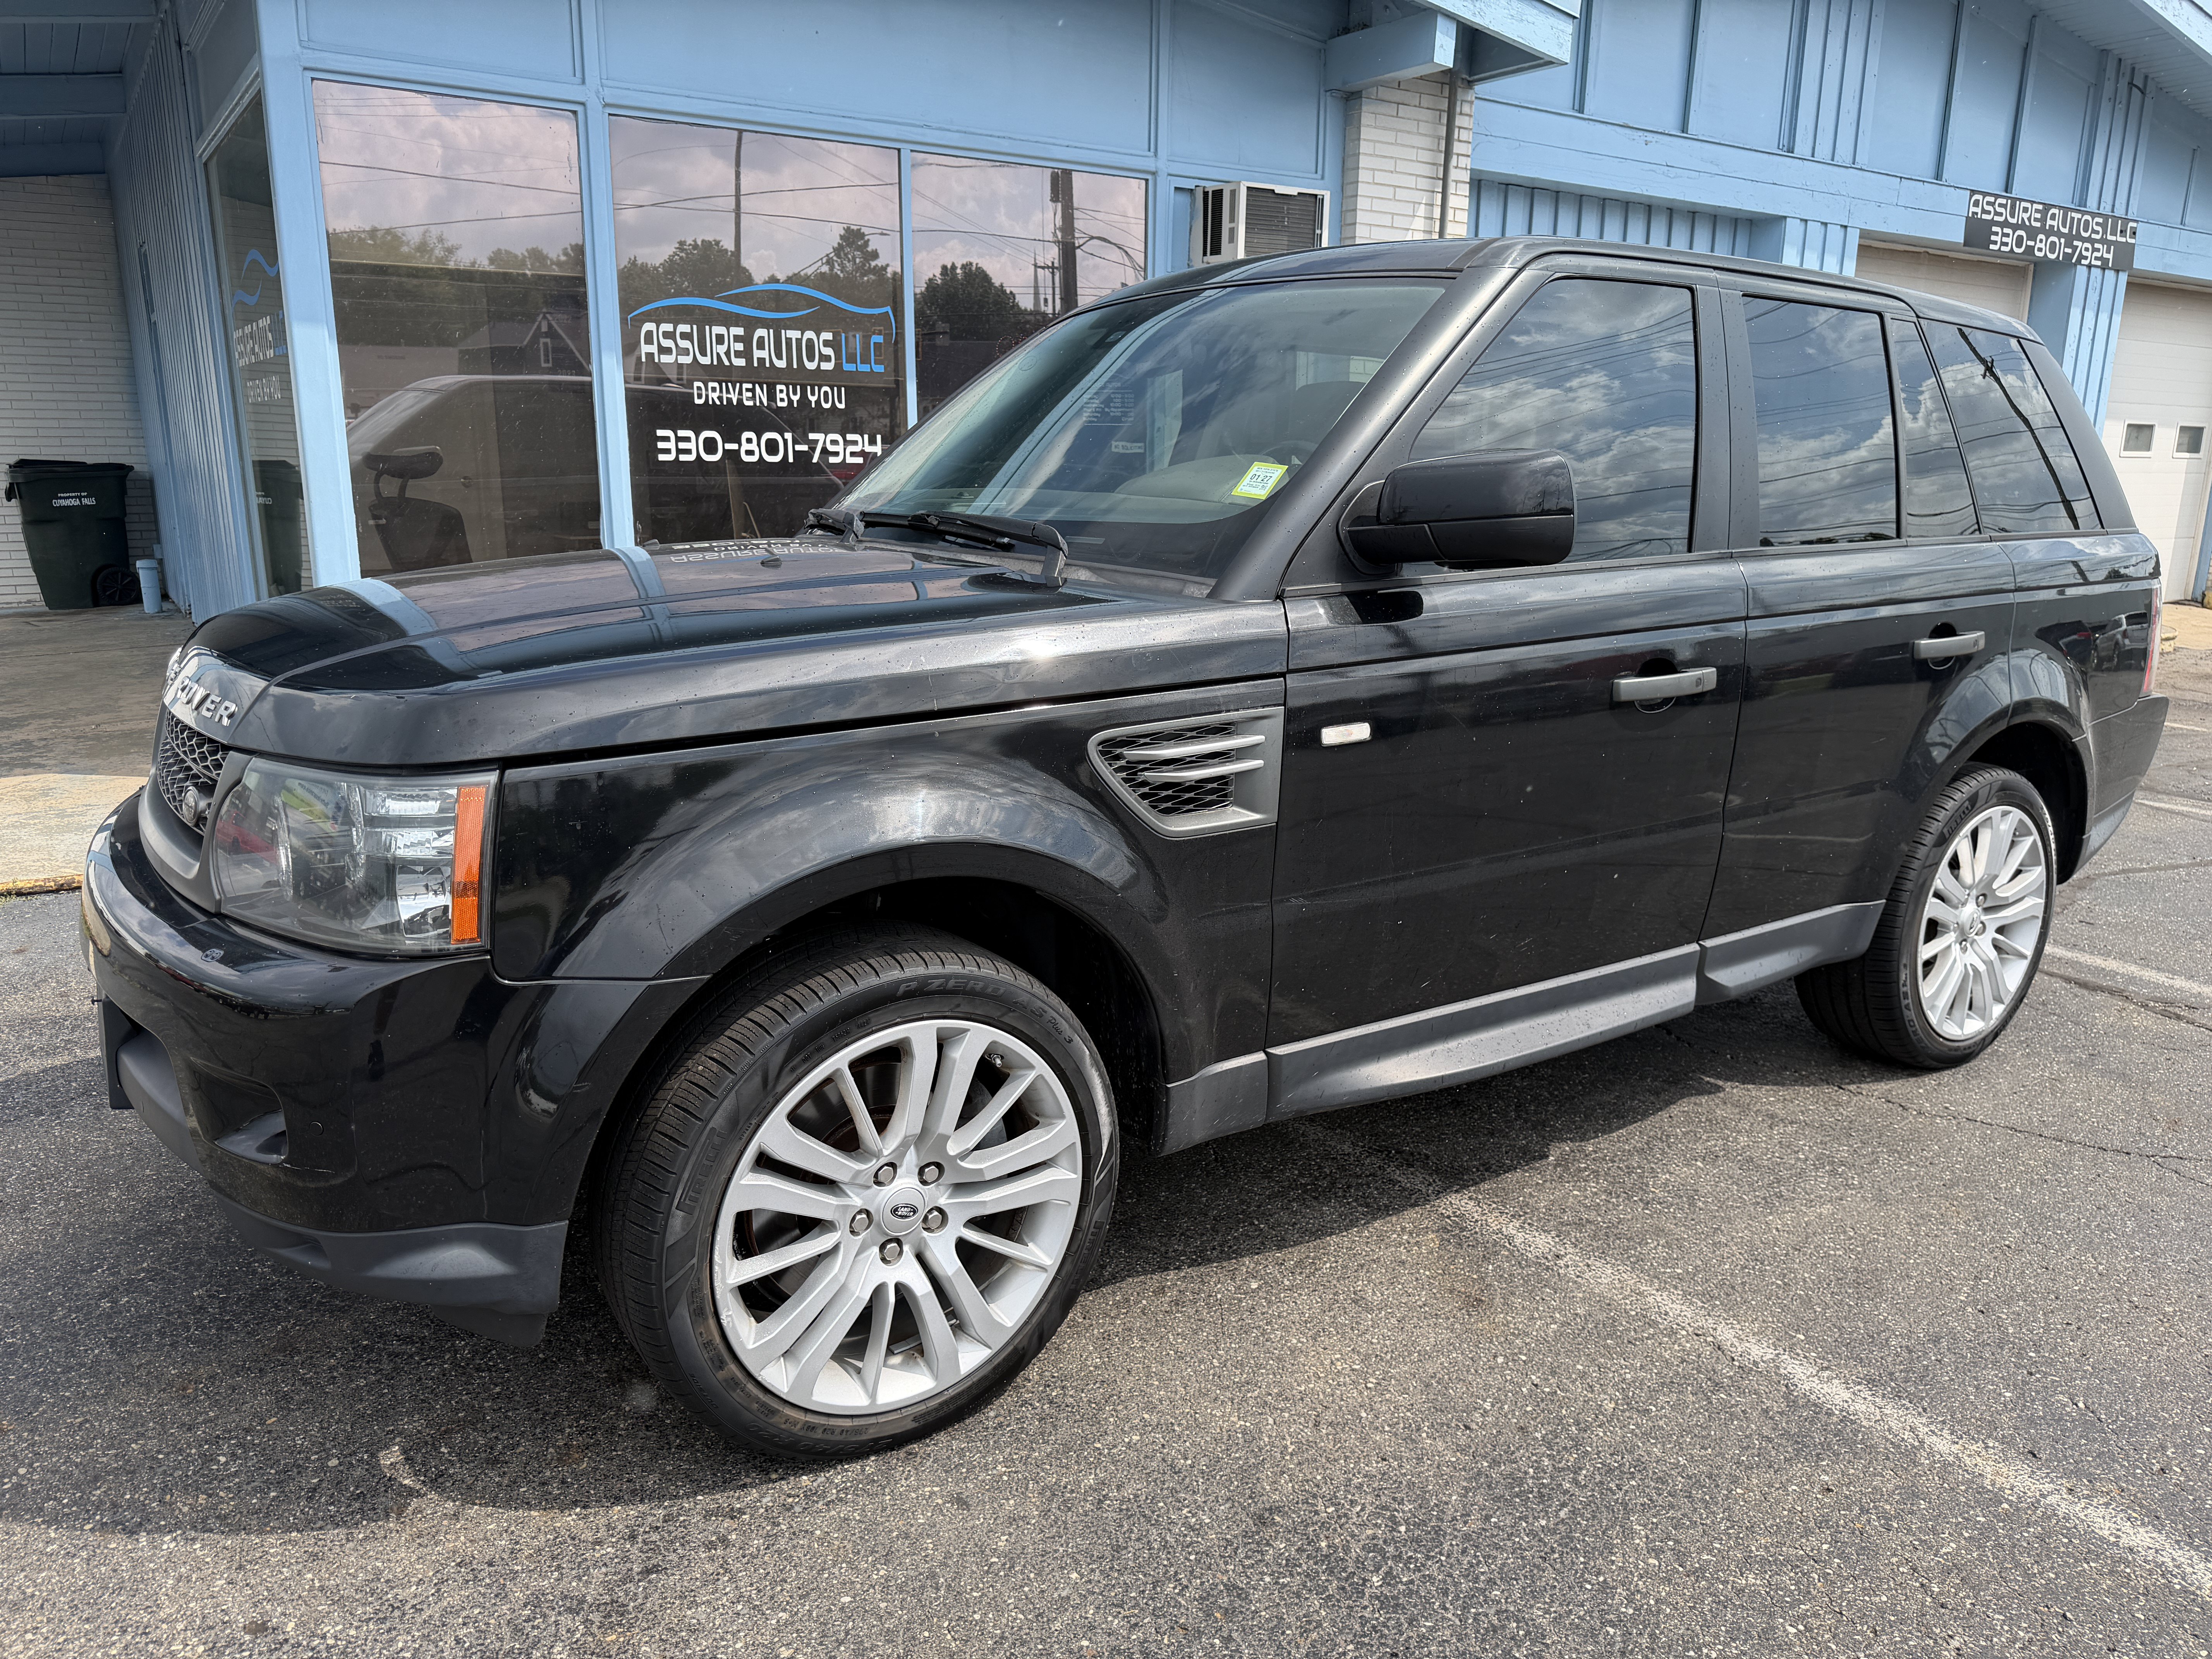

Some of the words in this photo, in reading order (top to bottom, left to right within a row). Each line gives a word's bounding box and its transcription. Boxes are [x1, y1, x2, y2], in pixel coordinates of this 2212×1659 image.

[1968, 194, 2043, 227] ASSURE
[1989, 226, 2114, 267] 330-801-7924
[253, 316, 274, 362] AUTOS
[641, 322, 746, 367] ASSURE
[753, 328, 835, 370] AUTOS
[841, 333, 885, 373] LLC
[693, 381, 768, 407] DRIVEN
[776, 385, 800, 408] BY
[807, 386, 846, 409] YOU
[656, 429, 882, 464] 330-801-7924
[52, 498, 81, 507] CUYAHOGA
[924, 979, 1007, 998] ZERO
[1012, 998, 1047, 1018] AS
[1046, 1015, 1063, 1036] Plus
[1063, 1035, 1074, 1044] 3
[675, 1127, 727, 1215] PIRELLI
